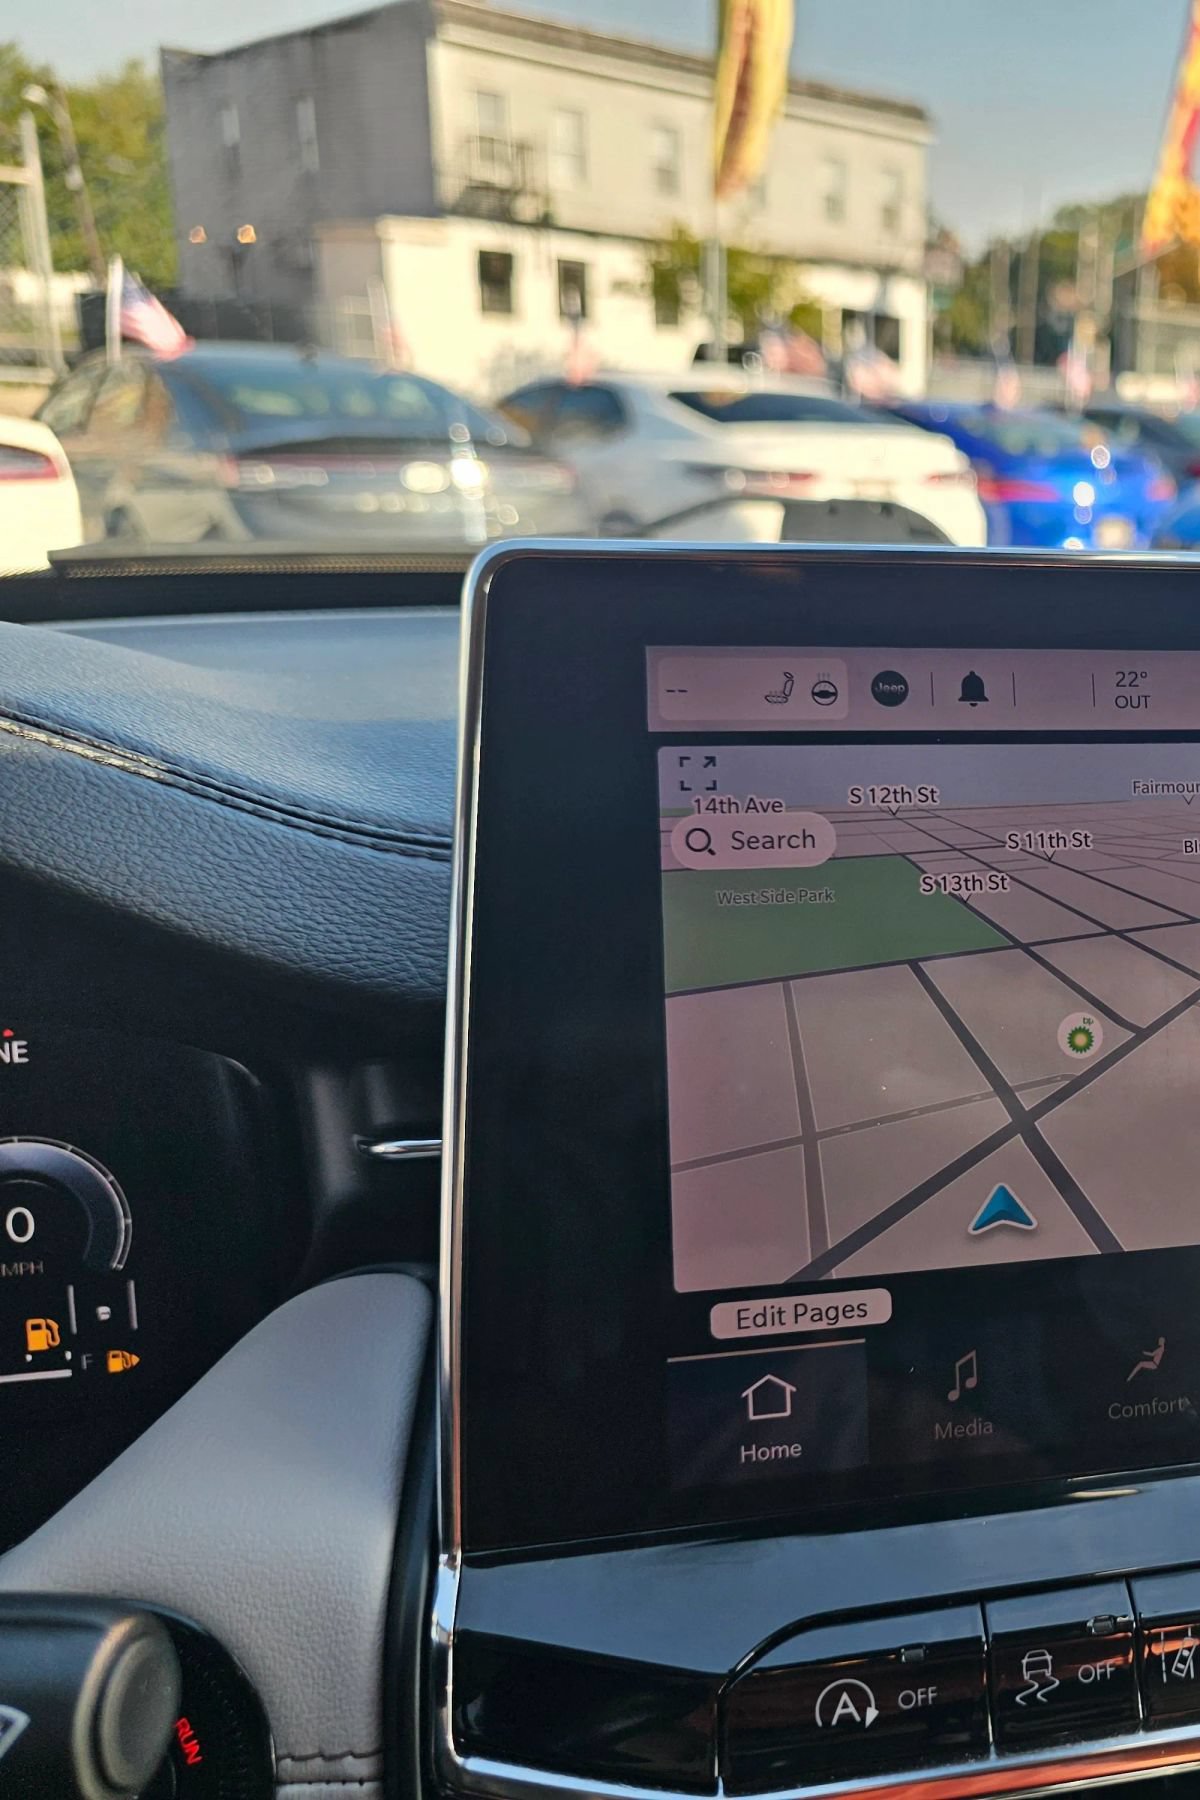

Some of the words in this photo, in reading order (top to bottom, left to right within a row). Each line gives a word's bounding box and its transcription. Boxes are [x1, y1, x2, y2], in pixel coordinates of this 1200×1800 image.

[875, 682, 905, 694] Jeep
[1115, 694, 1150, 709] OUT
[693, 796, 738, 814] 14th
[743, 796, 783, 814] Ave
[849, 788, 863, 804] S
[868, 786, 911, 803] 12th
[917, 786, 937, 803] St
[731, 828, 816, 851] Search
[1007, 833, 1020, 849] S
[1025, 832, 1067, 849] 11th
[1071, 832, 1091, 848] St
[922, 876, 935, 892] S
[939, 874, 983, 891] 13th
[987, 874, 1009, 890] St
[717, 889, 755, 906] West
[761, 888, 794, 904] Side
[799, 887, 834, 903] Park
[6, 1206, 35, 1243] 0
[0, 1260, 44, 1278] MPH
[735, 1306, 786, 1331] Edit
[793, 1299, 868, 1326] Pages
[1107, 1395, 1185, 1420] Comfort
[934, 1418, 994, 1440] Media
[740, 1440, 802, 1462] Home
[1078, 1661, 1117, 1683] OFF
[898, 1686, 938, 1710] OFF
[174, 1716, 203, 1766] RUN
